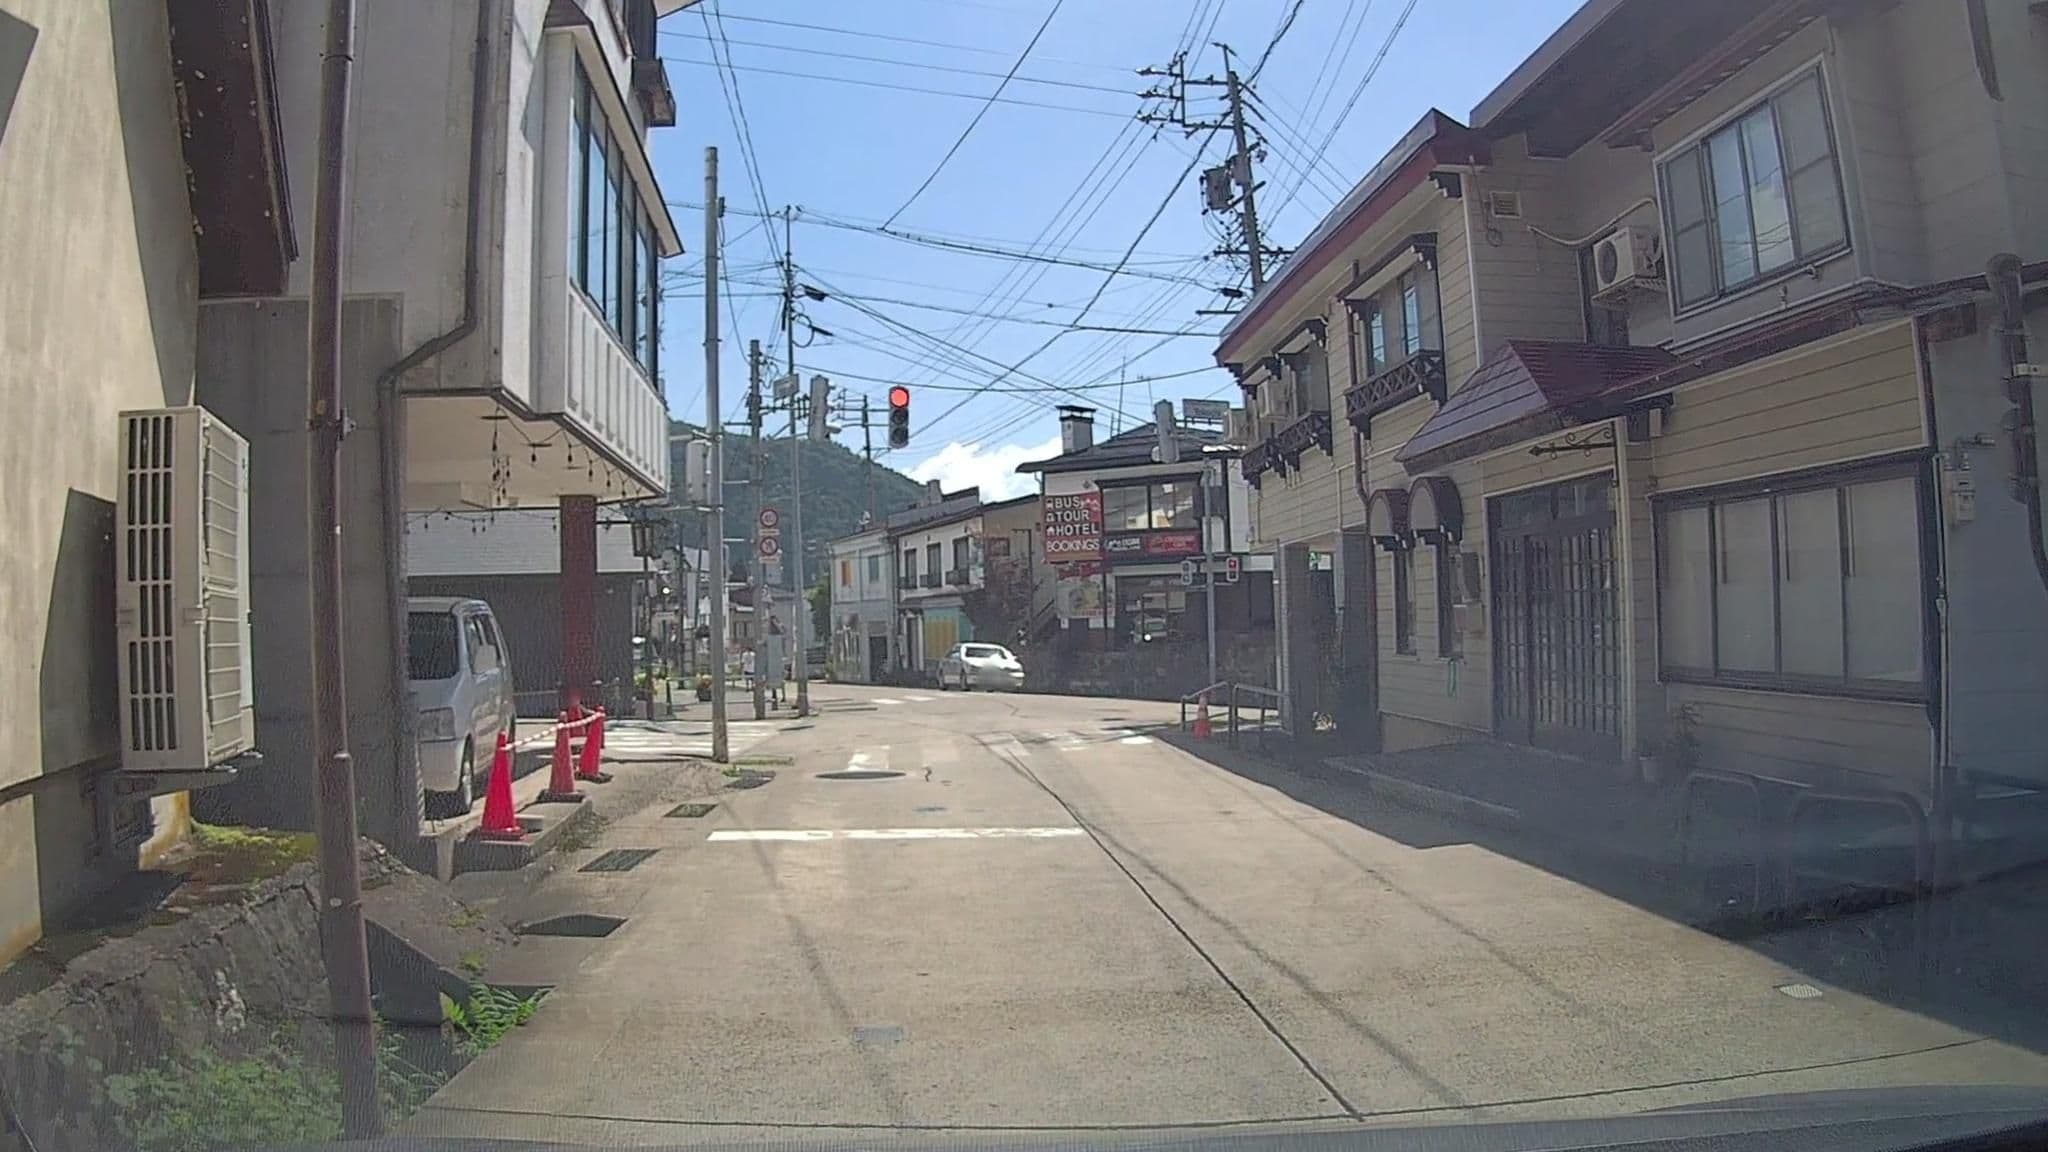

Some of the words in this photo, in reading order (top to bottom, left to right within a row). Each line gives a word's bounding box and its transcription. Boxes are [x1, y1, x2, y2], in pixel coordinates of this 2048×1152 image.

[1055, 496, 1080, 508] BUS
[1055, 509, 1089, 522] TOUR
[1056, 523, 1099, 536] HOTEL
[1047, 539, 1100, 552] BOOKINGS
